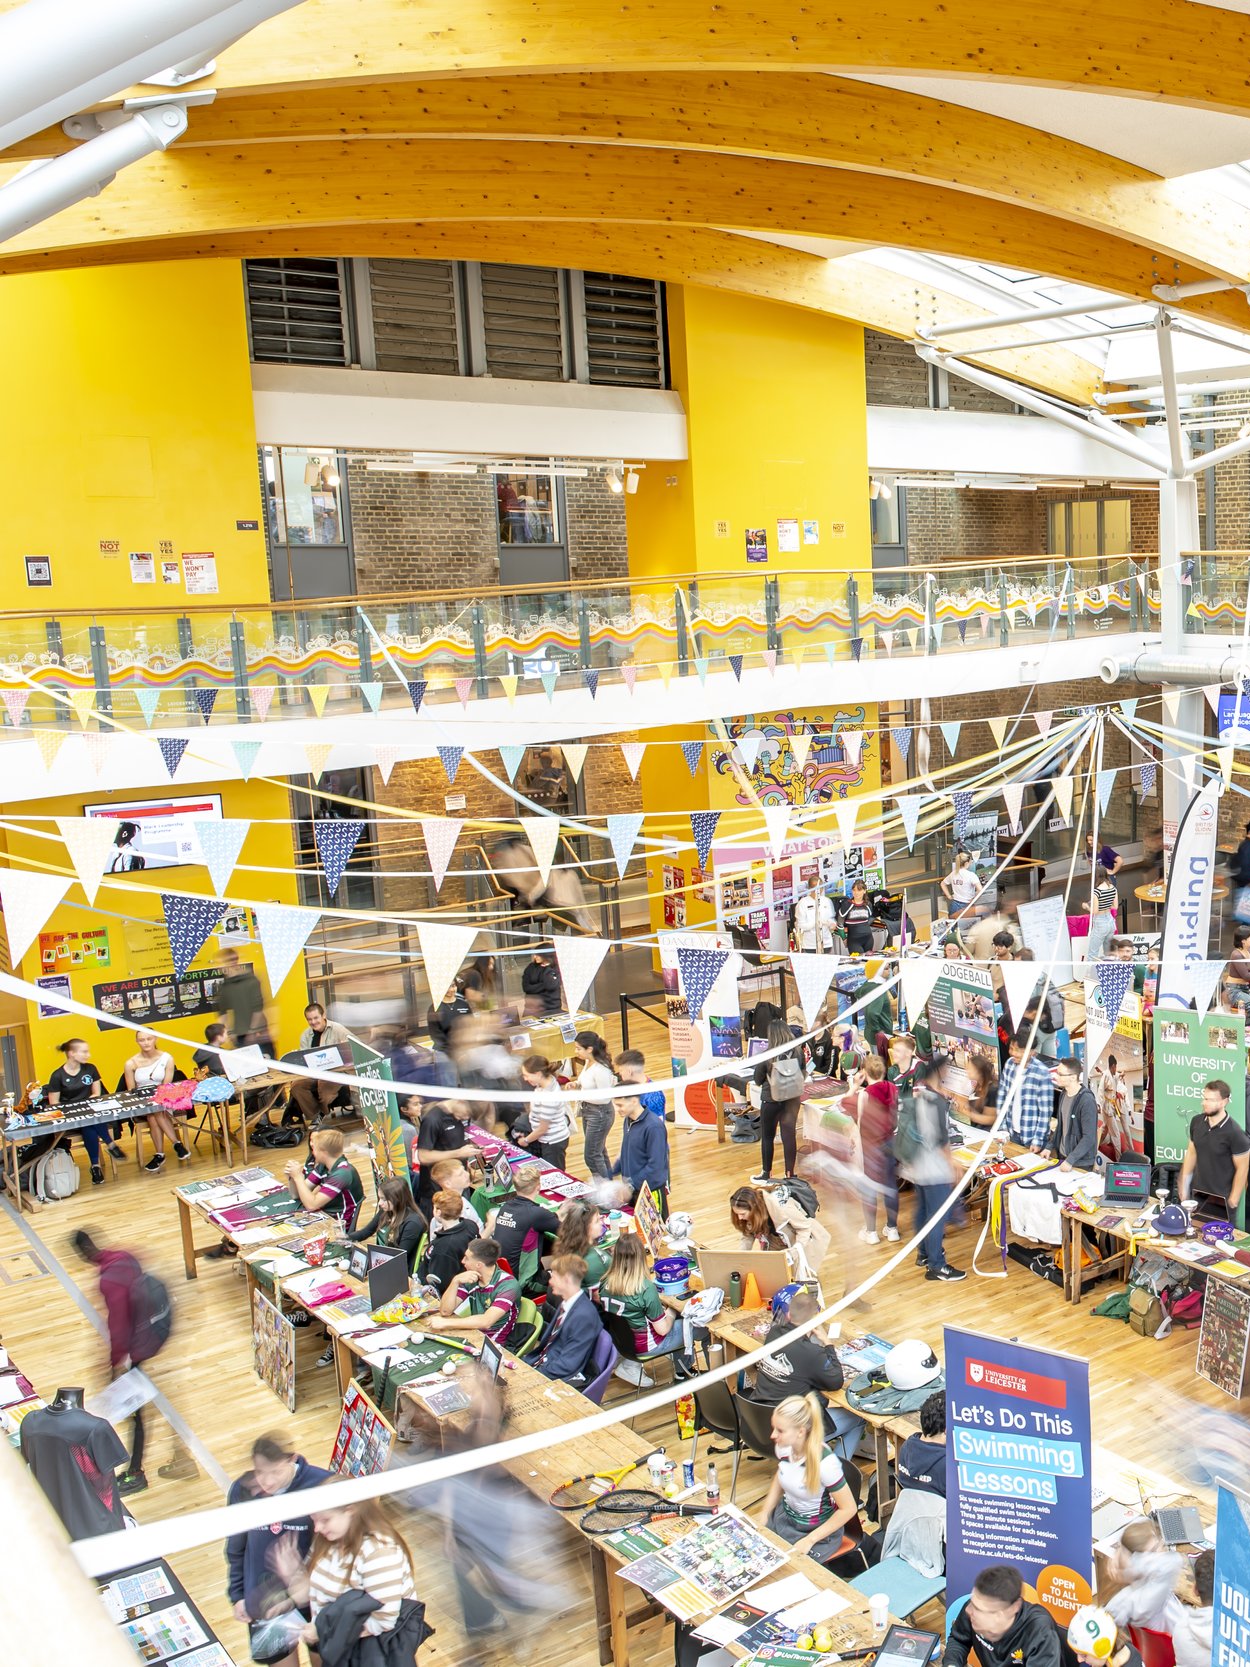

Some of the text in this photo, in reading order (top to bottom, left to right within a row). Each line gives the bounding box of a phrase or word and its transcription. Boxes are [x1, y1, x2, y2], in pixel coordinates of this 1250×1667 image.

[750, 911, 766, 919] TRANS
[40, 934, 50, 943] WE
[53, 934, 64, 943] ARE
[82, 929, 107, 939] CULTURE
[102, 970, 209, 993] WE ARE BLACK PORTS
[941, 963, 991, 987] ODGEBALL
[1094, 1008, 1105, 1019] JUST
[1130, 1020, 1140, 1031] ART
[1163, 1053, 1236, 1072] UNIVERSITY
[1191, 1072, 1207, 1084] OF
[52, 1103, 146, 1126] DanceSport
[601, 1296, 626, 1317] 17
[985, 1369, 1018, 1383] UNIVERSITY
[985, 1375, 1027, 1392] LEICESTER
[952, 1400, 1073, 1436] Let's Do This
[959, 1430, 1075, 1474] Swimming
[962, 1464, 1054, 1499] Lessons
[959, 1494, 968, 1502] Six
[983, 1499, 1014, 1509] swimming
[1015, 1502, 1036, 1511] lessons
[1037, 1506, 1051, 1514] with
[960, 1502, 972, 1511] fully
[973, 1506, 998, 1515] qualified
[960, 1510, 976, 1519] Three
[984, 1514, 1006, 1523] minute
[1006, 1518, 1031, 1526] sessions
[961, 1529, 1047, 1548] Booking information available
[966, 1520, 984, 1528] spaces
[984, 1522, 1011, 1532] available
[1012, 1525, 1021, 1533] for
[1022, 1527, 1036, 1535] each
[1036, 1530, 1058, 1540] session.
[969, 1541, 996, 1549] reception
[1052, 1576, 1075, 1591] OPEN
[1050, 1586, 1078, 1602] TO ALL
[1085, 1619, 1101, 1639] 9
